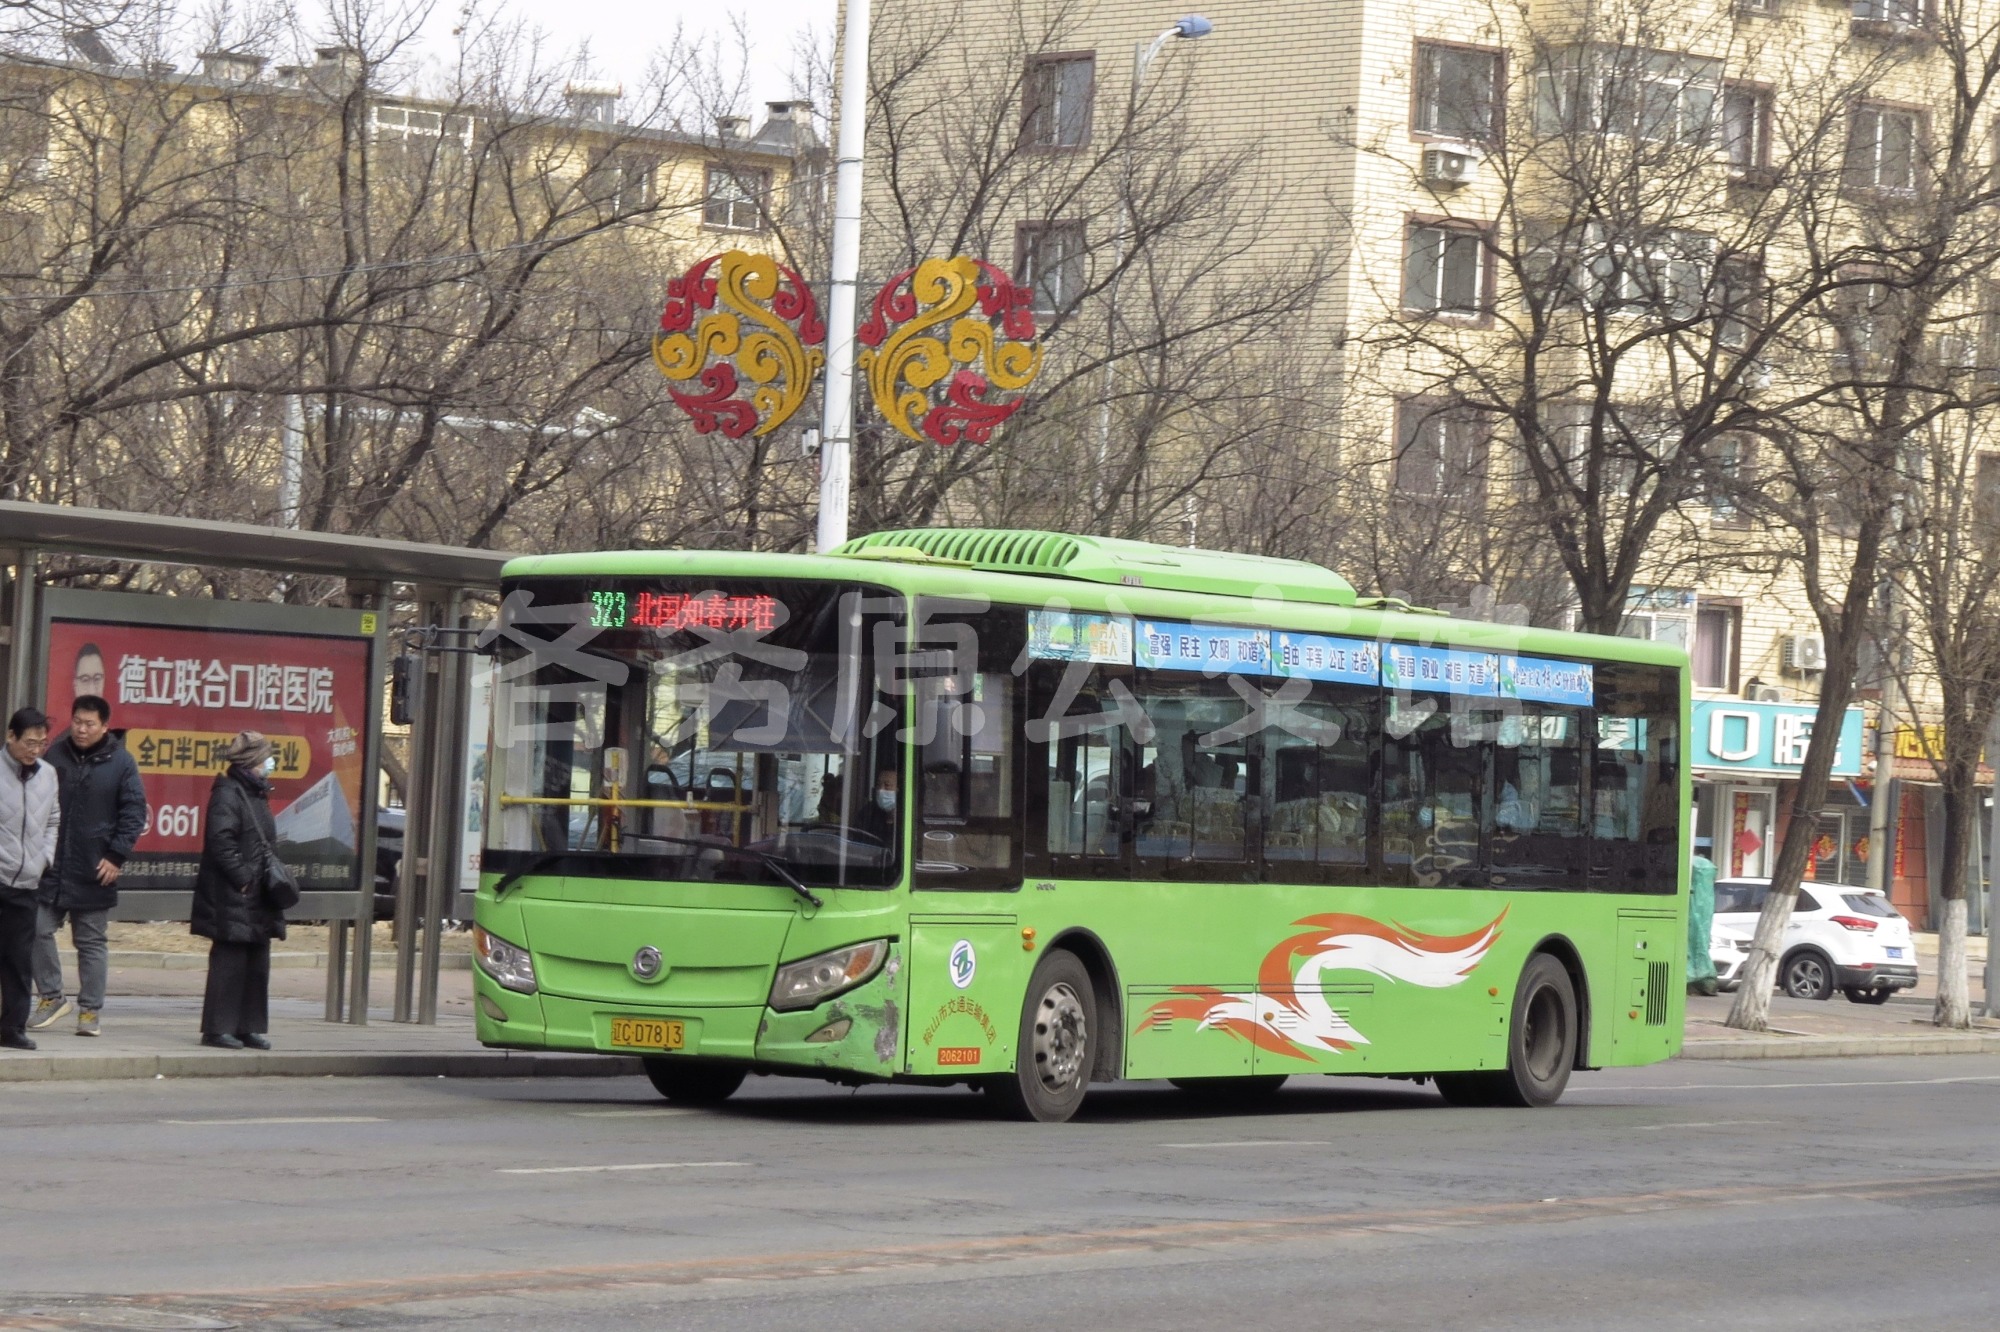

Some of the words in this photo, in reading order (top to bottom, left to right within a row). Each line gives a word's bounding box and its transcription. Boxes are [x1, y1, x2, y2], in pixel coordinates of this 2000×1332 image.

[590, 591, 627, 628] 323
[632, 592, 776, 631] 北国知春开往
[1149, 633, 1172, 657] 富强
[1179, 636, 1201, 659] 民主
[1208, 638, 1230, 661] 文明
[1237, 639, 1259, 663] 和谐
[1283, 643, 1300, 666] 自由
[1306, 647, 1323, 669] 平等
[1329, 649, 1346, 671] 公正
[1351, 651, 1369, 673] 法治
[118, 654, 334, 714] 德立联合口腔医院
[1398, 656, 1416, 678] 爱国
[1421, 658, 1439, 680] 敬业
[1445, 660, 1462, 682] 诚信
[1468, 663, 1485, 685] 友善
[157, 804, 200, 837] 661
[940, 1049, 979, 1062] 2062101
